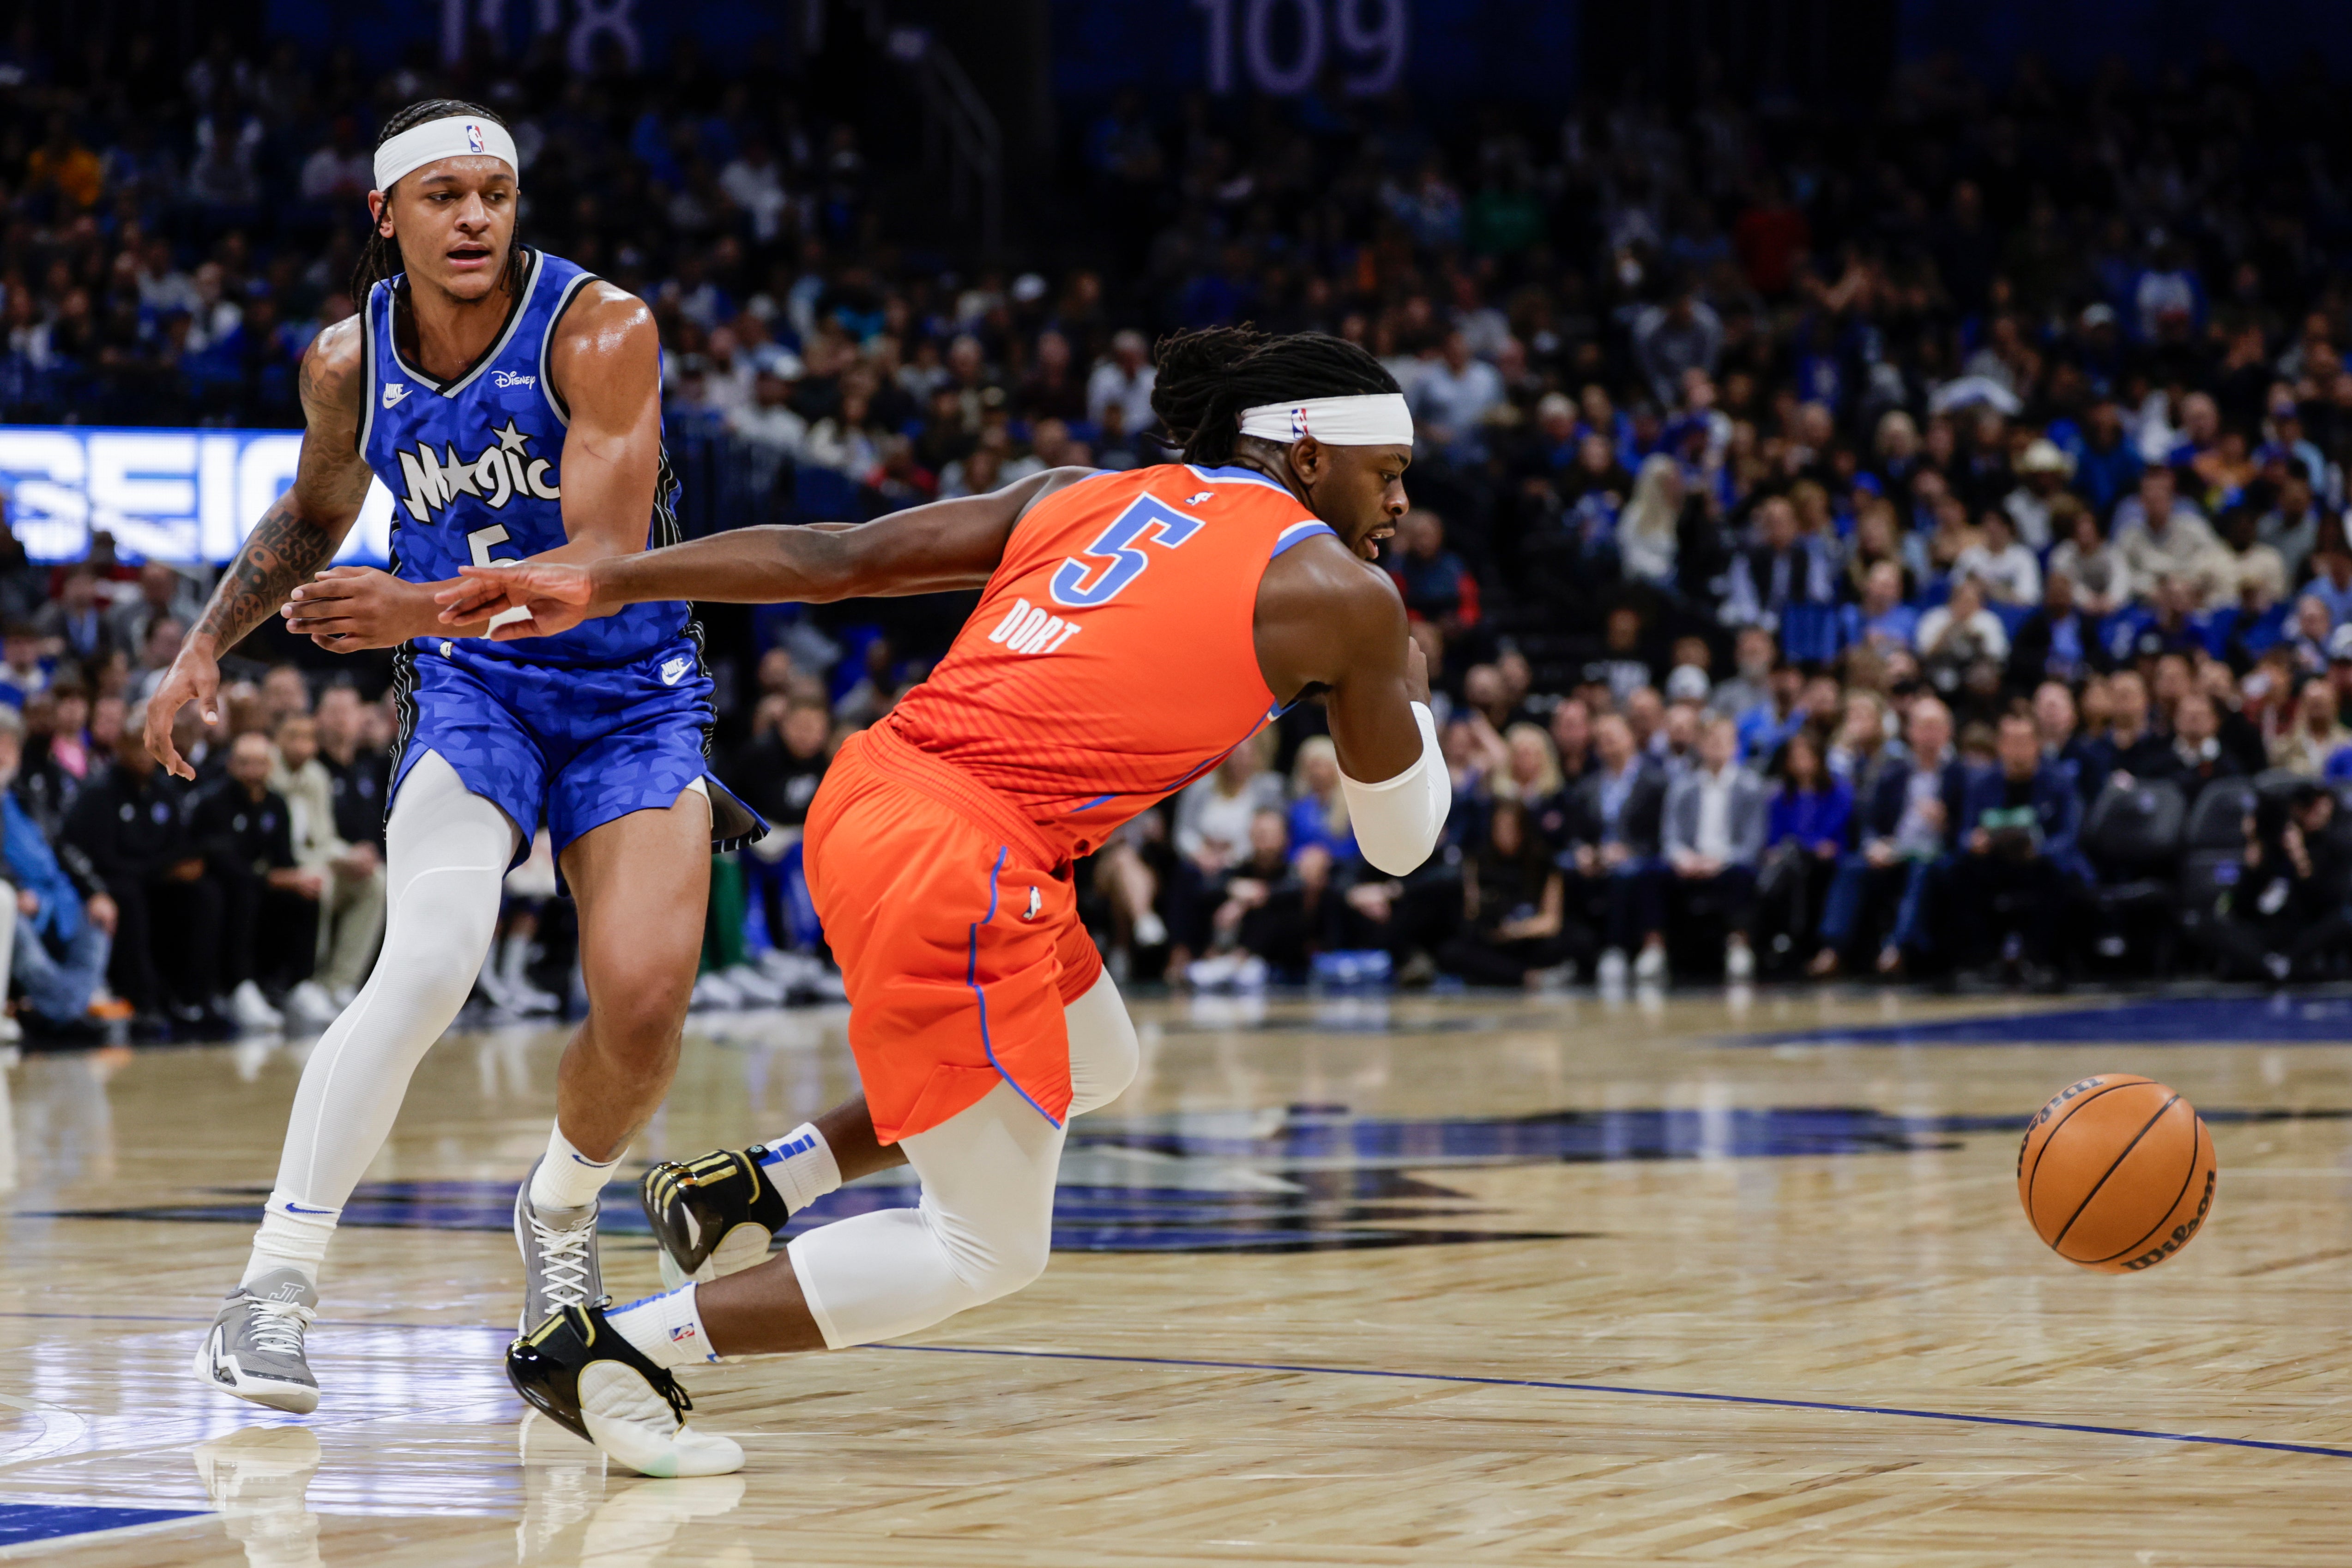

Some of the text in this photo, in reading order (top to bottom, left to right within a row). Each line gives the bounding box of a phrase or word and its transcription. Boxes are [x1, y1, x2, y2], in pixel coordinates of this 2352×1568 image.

[385, 383, 404, 398] NIKE
[491, 371, 536, 390] Disney
[1049, 491, 1206, 607] 5
[989, 598, 1081, 654] DORT
[661, 657, 684, 675] NIKE
[2120, 1170, 2215, 1270] Wilson
